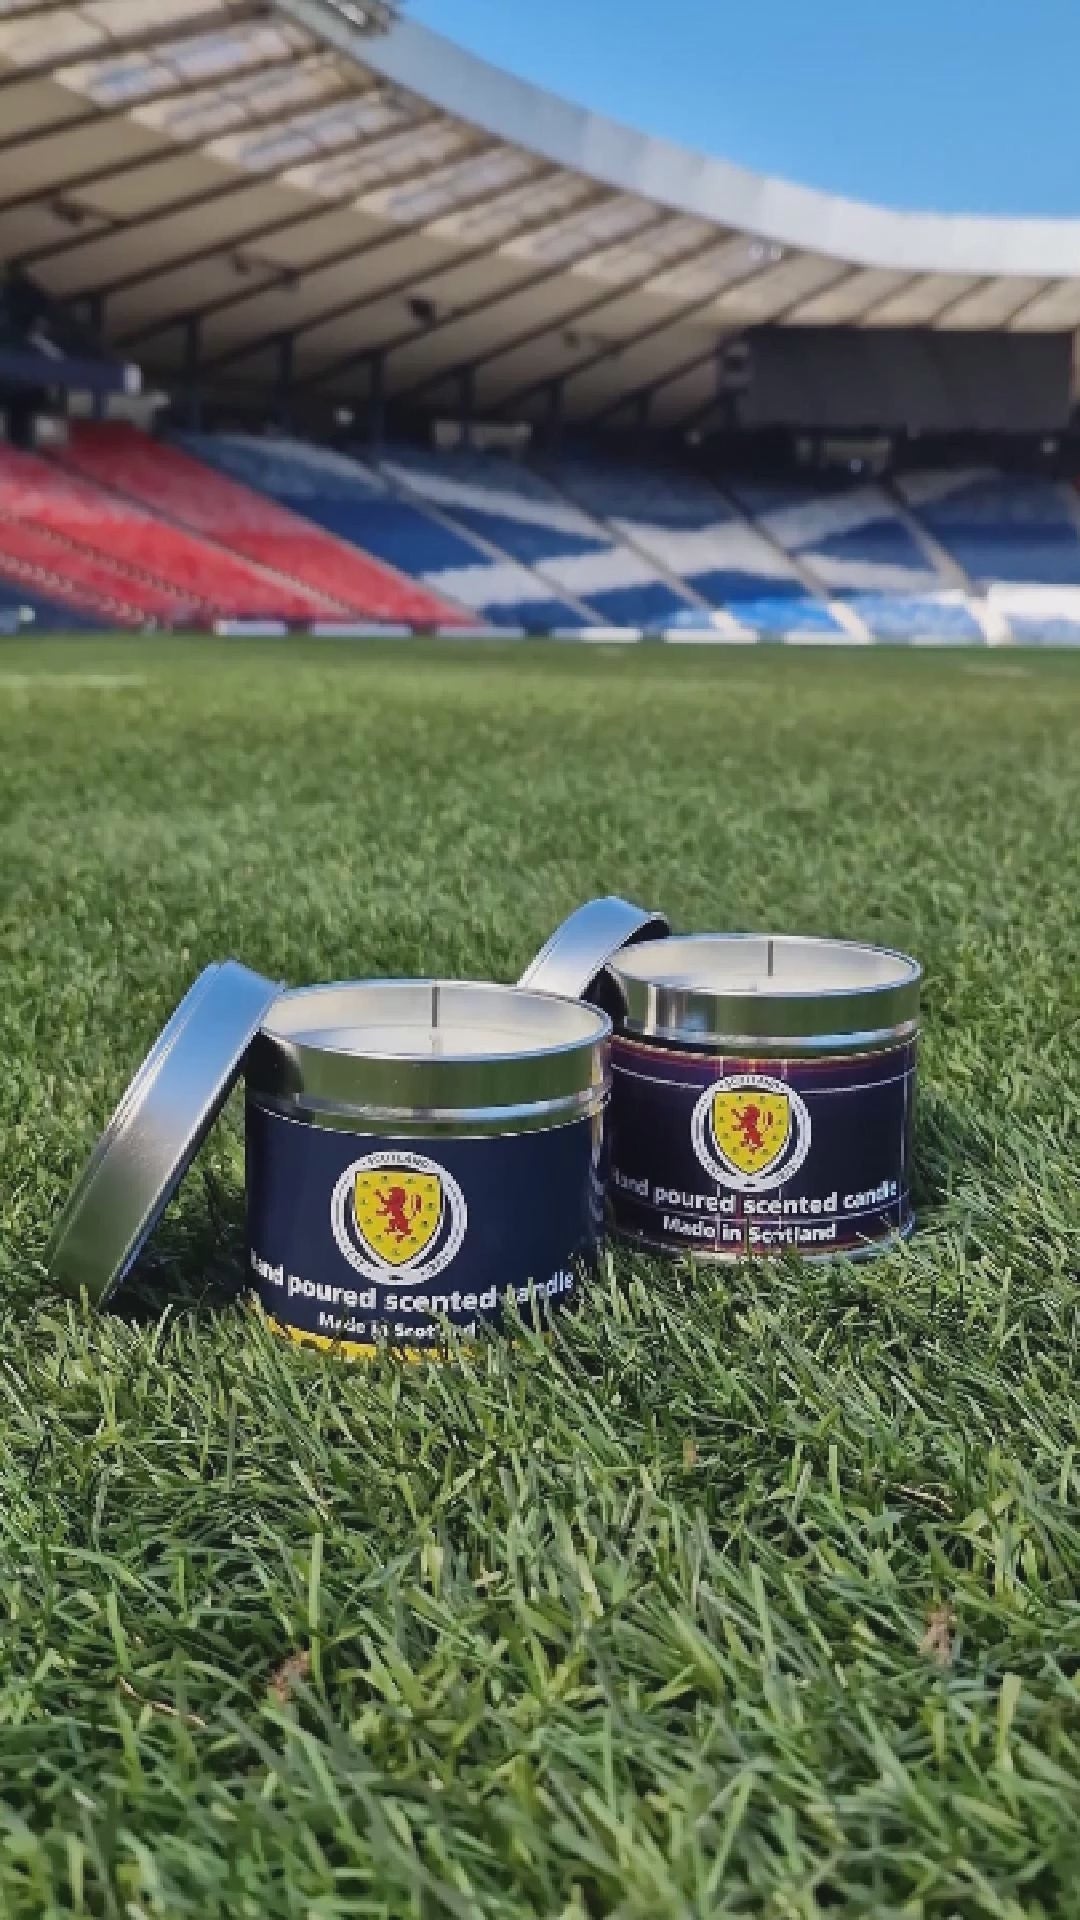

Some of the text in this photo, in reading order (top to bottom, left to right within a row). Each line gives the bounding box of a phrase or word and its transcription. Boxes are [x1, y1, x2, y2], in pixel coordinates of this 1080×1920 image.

[653, 1186, 737, 1214] poured
[743, 1191, 838, 1214] scented
[843, 1179, 898, 1209] candle
[663, 1215, 836, 1243] Made in Scotland
[287, 1274, 377, 1309] poured
[383, 1284, 497, 1312] scented
[503, 1269, 574, 1304] andle
[318, 1311, 366, 1334] Made
[394, 1320, 477, 1341] Scotd
